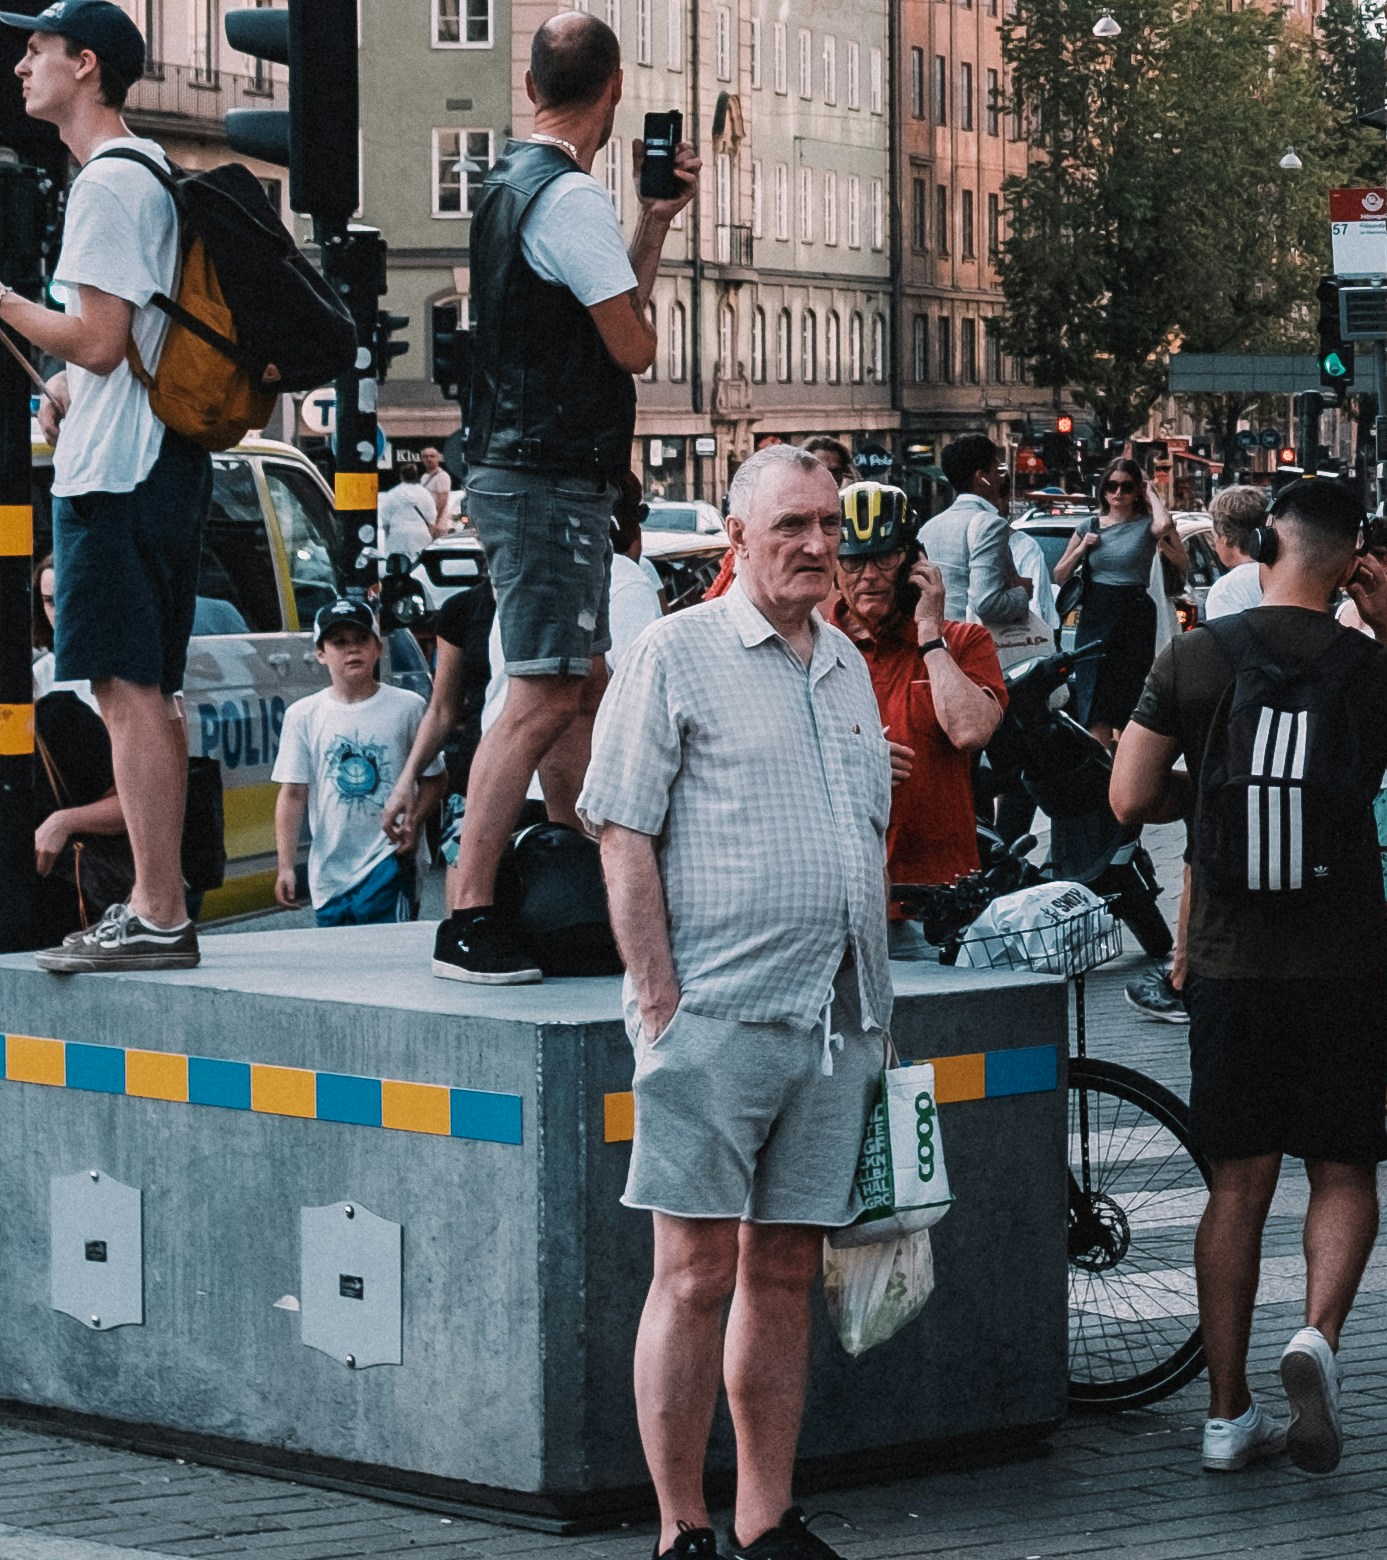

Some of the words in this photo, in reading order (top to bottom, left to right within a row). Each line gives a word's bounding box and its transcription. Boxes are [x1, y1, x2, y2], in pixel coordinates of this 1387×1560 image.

[1332, 223, 1349, 236] 57
[198, 695, 286, 770] POLIS
[914, 1091, 937, 1183] coop
